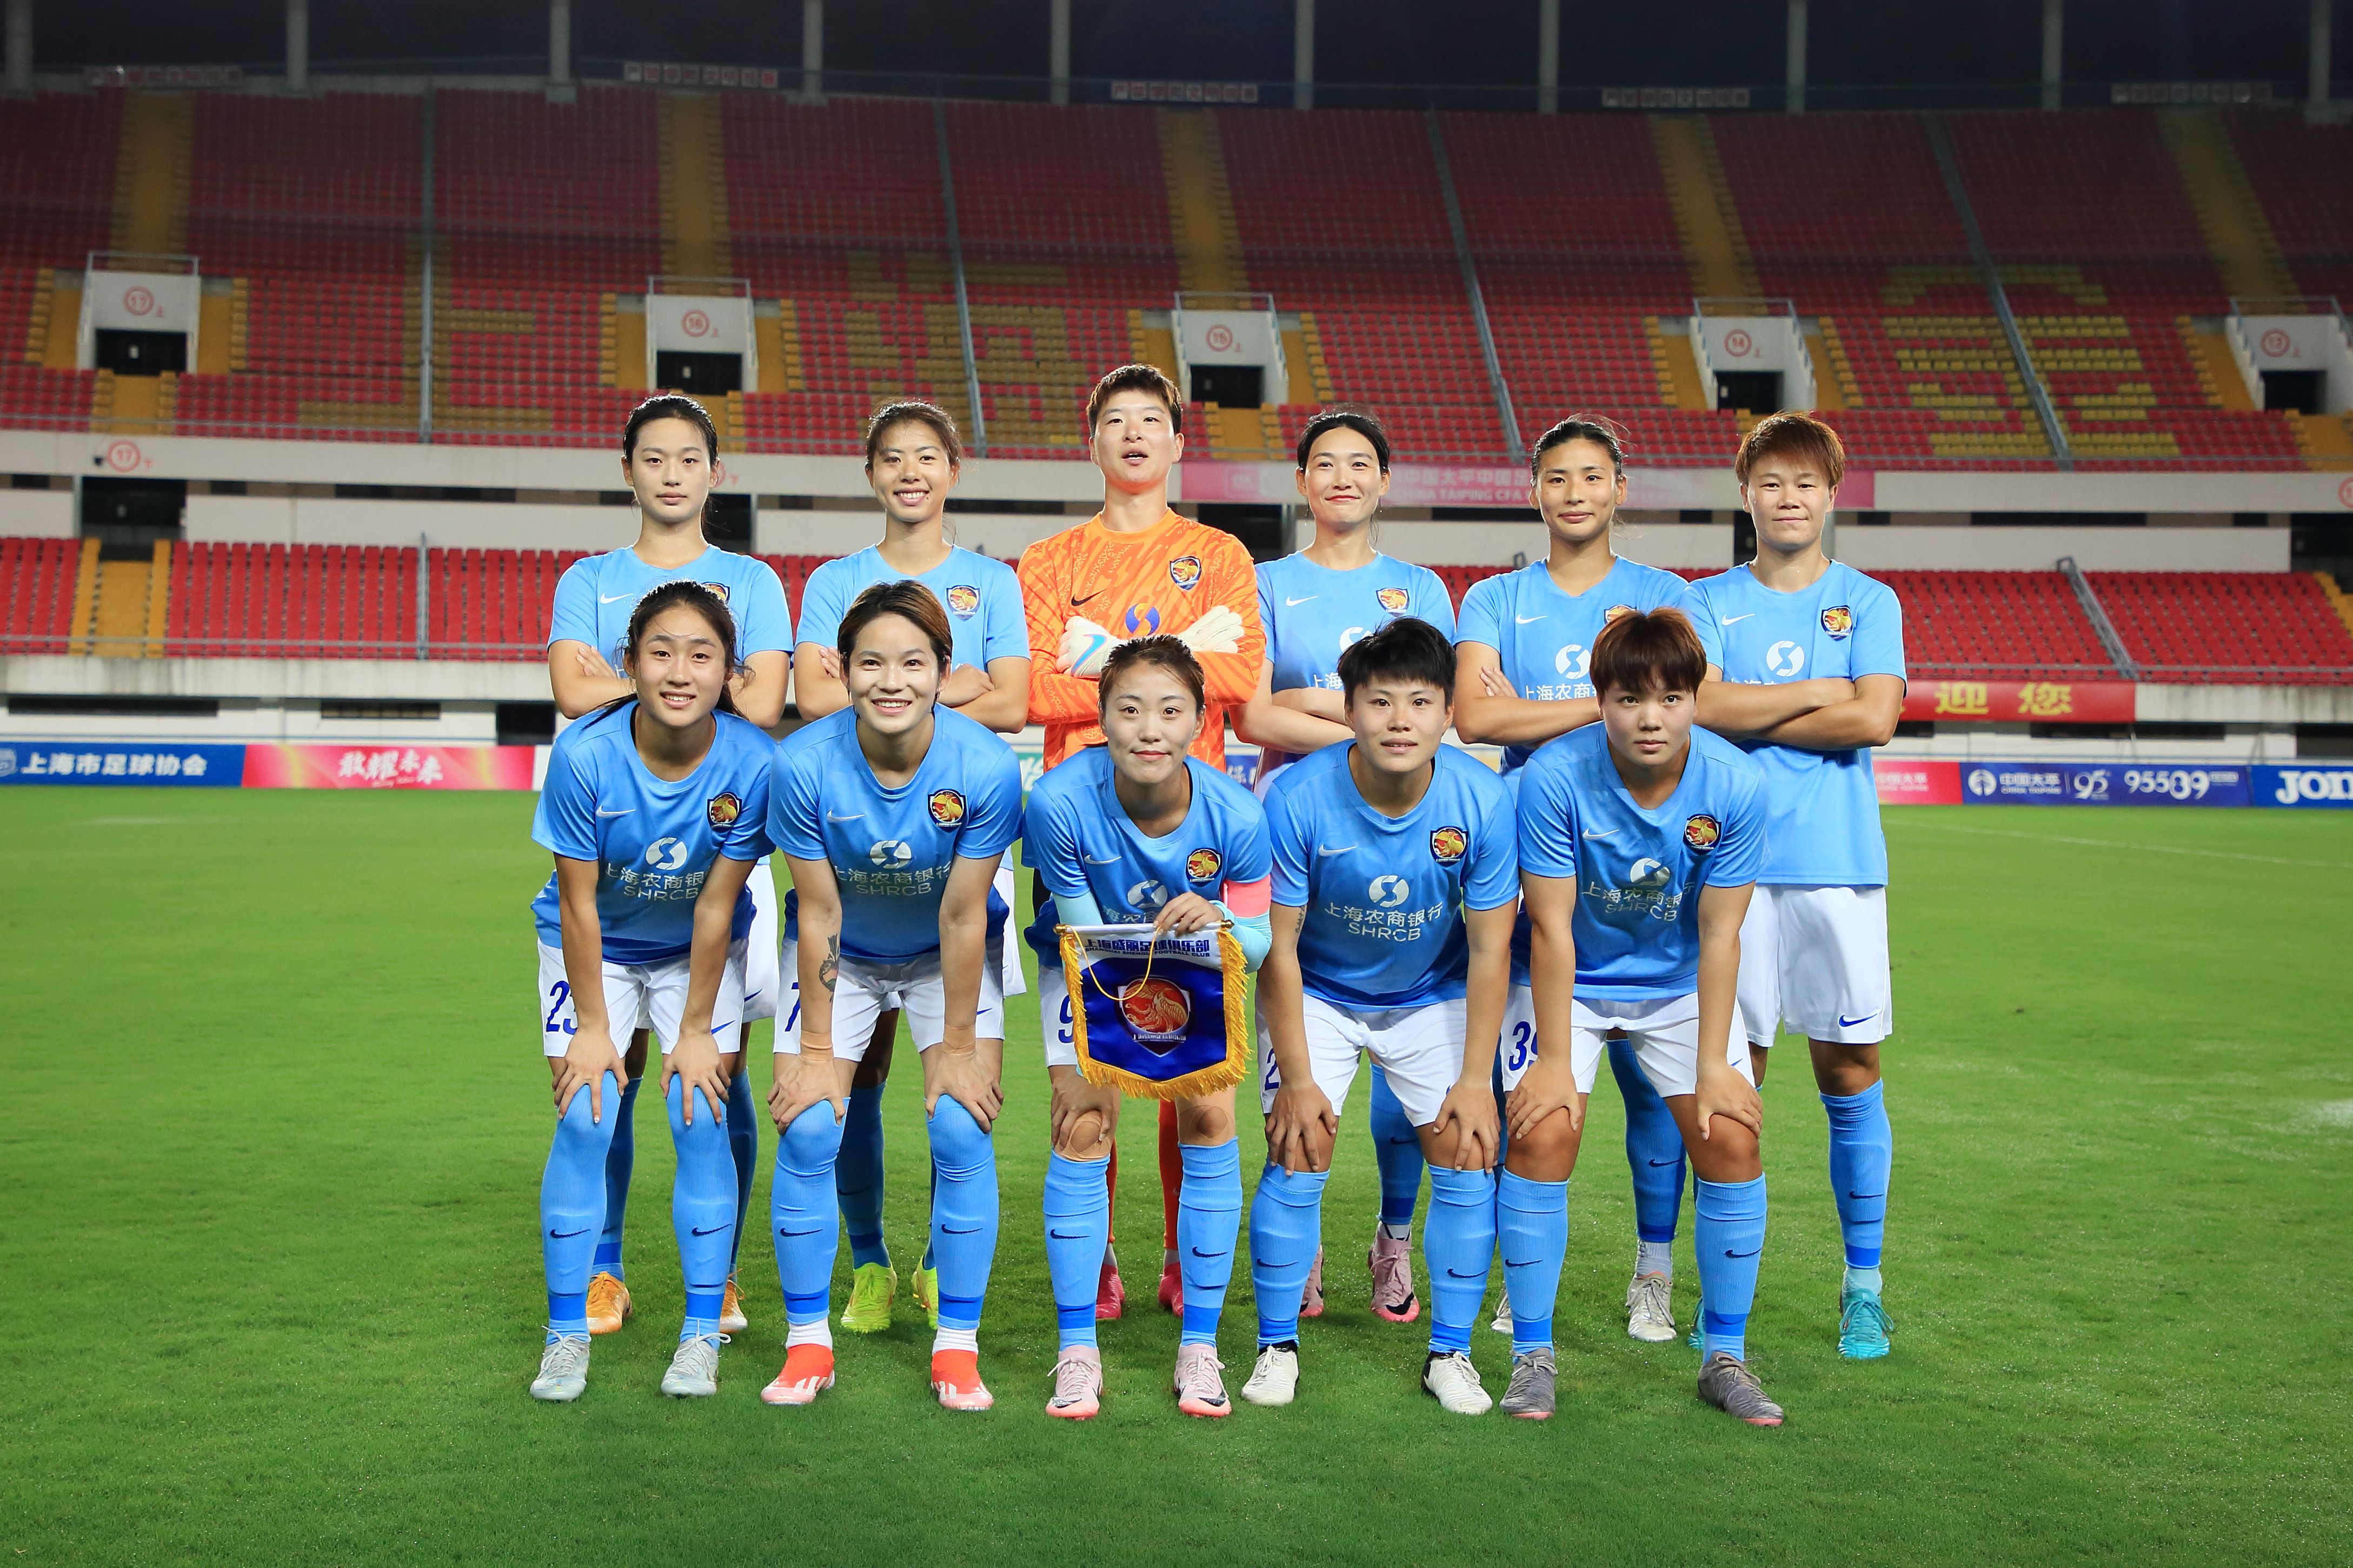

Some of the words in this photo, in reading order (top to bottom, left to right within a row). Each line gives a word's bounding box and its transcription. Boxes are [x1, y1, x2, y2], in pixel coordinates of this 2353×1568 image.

[1526, 682, 1597, 701] 上海农商
[1900, 682, 2072, 716] 迎您
[21, 752, 208, 776] 上海市足球协会
[605, 863, 709, 890] 上海农商银
[623, 885, 700, 902] SHRCB
[856, 882, 932, 896] SHRCB
[1325, 901, 1444, 928] 上海农商银行
[1605, 902, 1677, 922] SHRCB
[1348, 923, 1421, 942] SHRCB
[1508, 1020, 1538, 1071] 3
